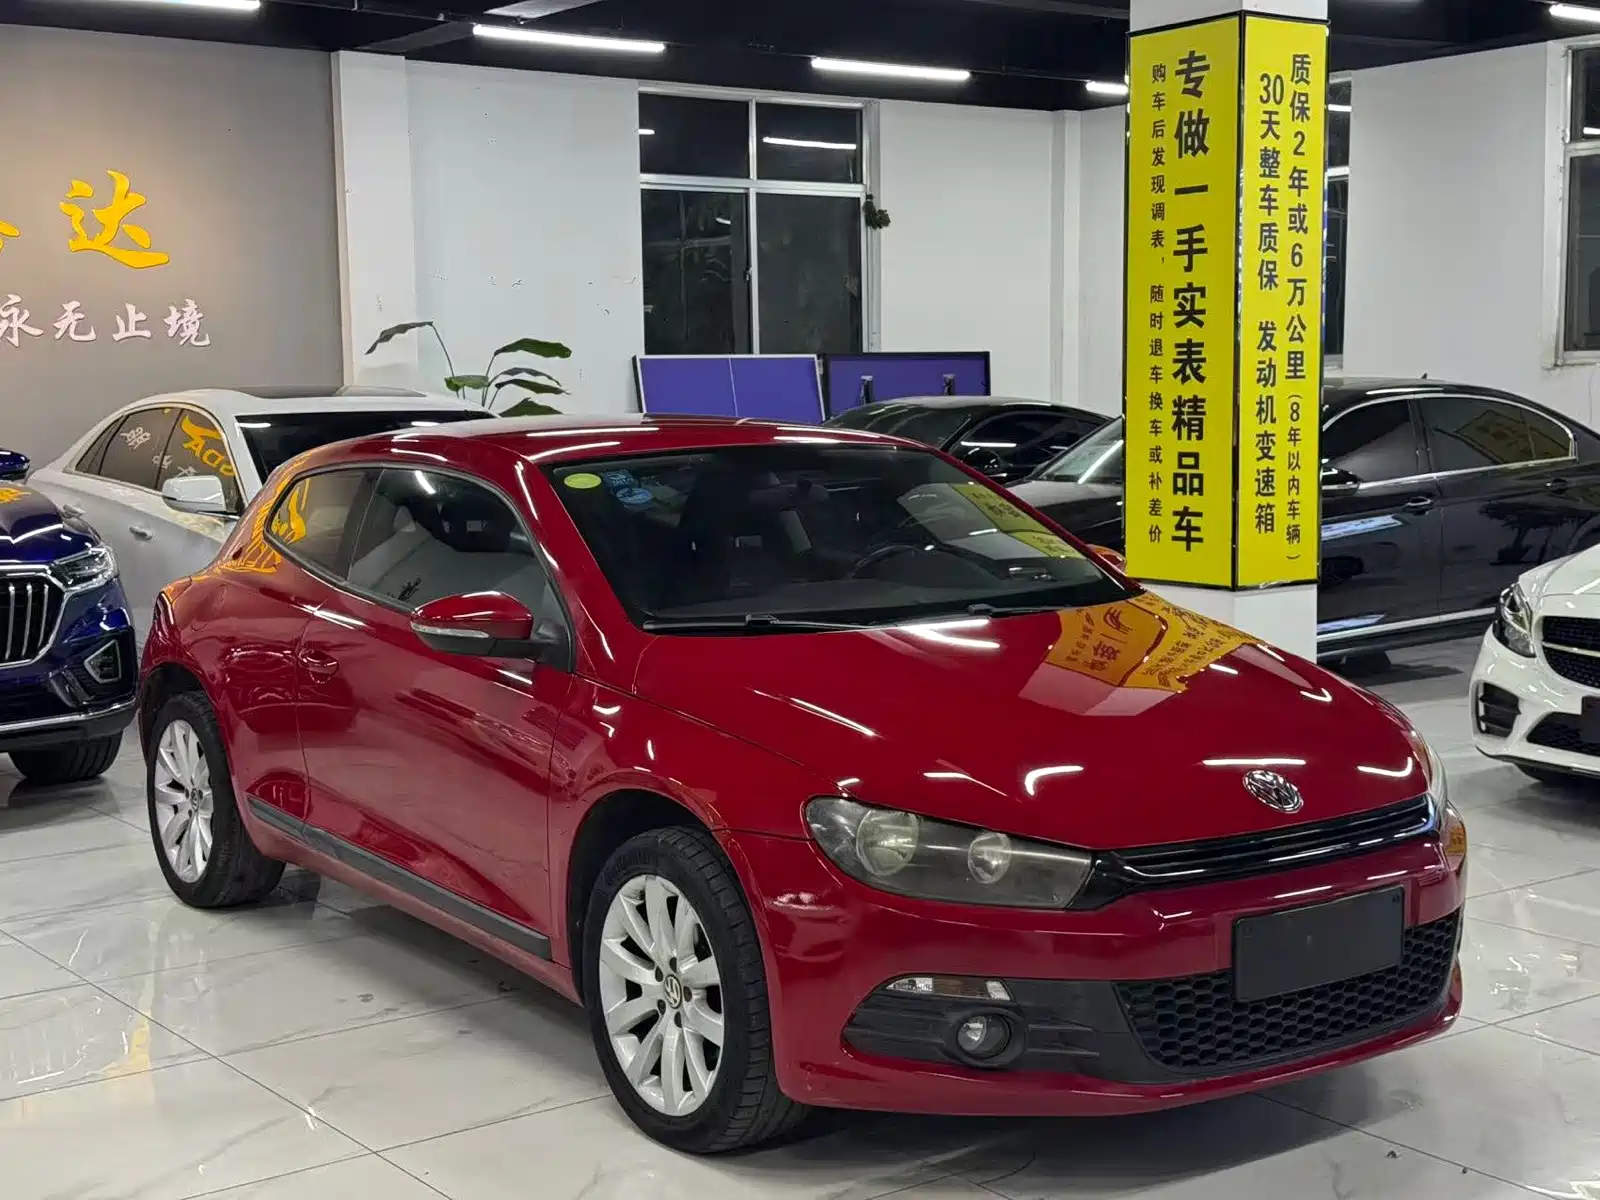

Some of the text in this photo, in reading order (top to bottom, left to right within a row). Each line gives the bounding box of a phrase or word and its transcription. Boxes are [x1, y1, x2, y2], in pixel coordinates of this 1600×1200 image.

[0, 168, 170, 270] 达
[1171, 50, 1211, 552] 专做一手实表精品车
[1254, 73, 1285, 534] 30天整车质保 发动机变速箱
